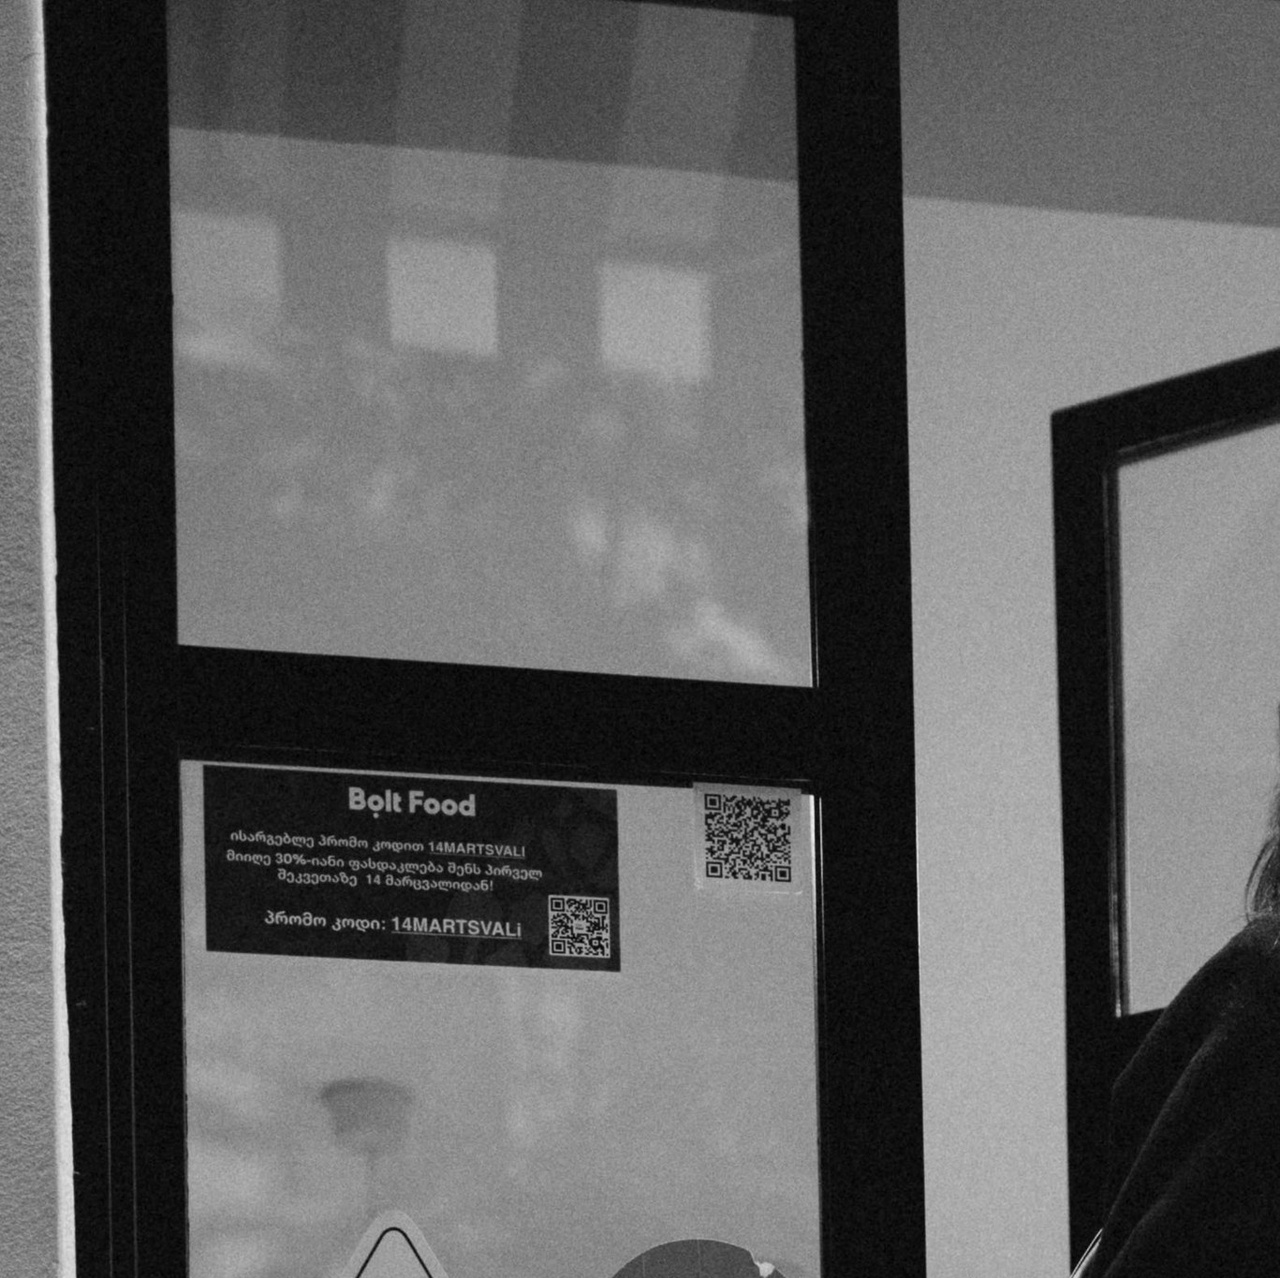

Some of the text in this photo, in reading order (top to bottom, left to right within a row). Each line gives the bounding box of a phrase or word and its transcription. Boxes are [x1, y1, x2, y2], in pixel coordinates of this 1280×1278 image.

[349, 787, 475, 818] Bolt Food
[230, 830, 525, 857] ისარგებლე პრომო კოდით 14MARTSVALI
[226, 849, 542, 880] მიიღე 30%-იანი ფასდაკლება შენს პირველ
[278, 868, 493, 892] შეკვეთაზე 14 მარცვალიდან!
[265, 910, 326, 926] პრომო
[332, 918, 385, 932] კოდი:
